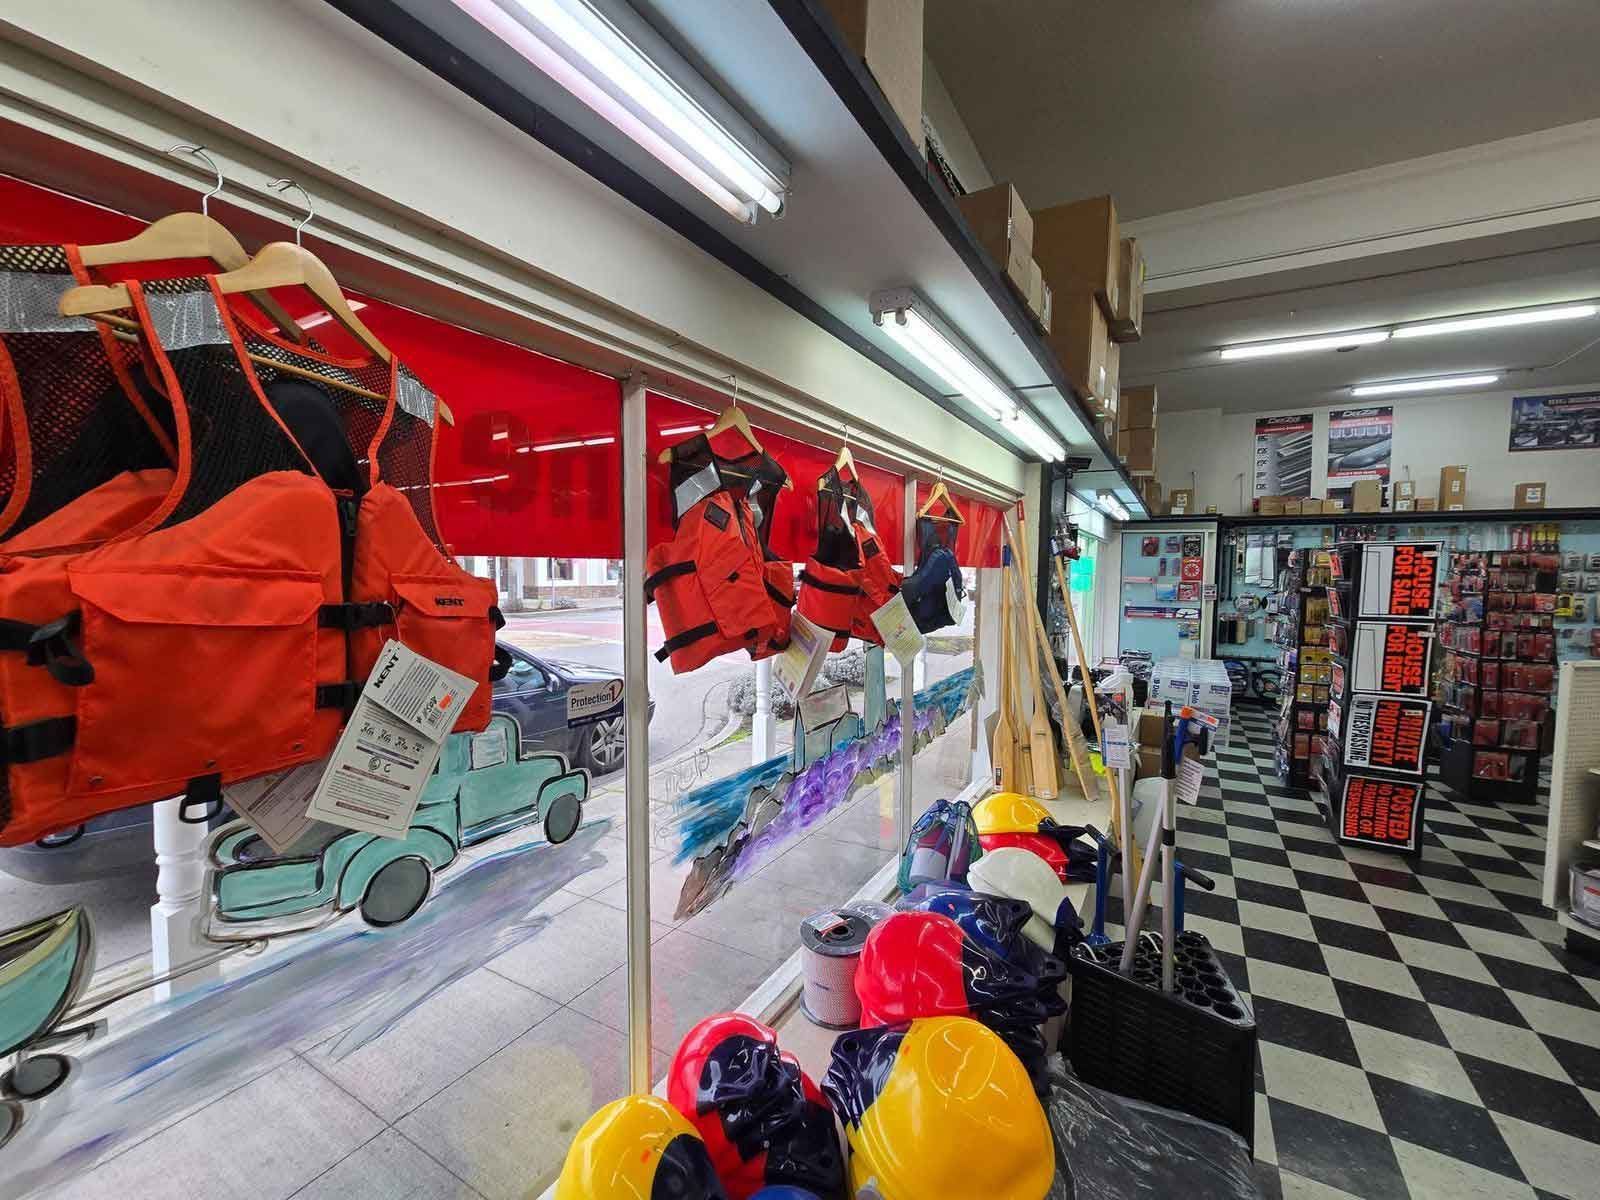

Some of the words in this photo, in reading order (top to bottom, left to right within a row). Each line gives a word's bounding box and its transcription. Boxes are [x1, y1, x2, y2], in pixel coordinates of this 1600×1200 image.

[1393, 546, 1415, 575] FOR
[1391, 579, 1411, 615] SALE
[1411, 552, 1433, 609] HOUSE
[1386, 625, 1407, 653] FOR
[374, 653, 399, 688] KENT
[1383, 655, 1404, 692] RENT
[1403, 632, 1425, 686] HOUSE
[571, 692, 611, 709] Protection
[1354, 700, 1374, 710] NO
[1350, 711, 1371, 762] TRESPASSING
[1371, 701, 1401, 765] PROPERTY
[1360, 783, 1377, 817] FISHING
[1378, 783, 1393, 795] NO
[1345, 778, 1364, 838] TRESPASSING
[1374, 796, 1391, 839] HUNTING
[1389, 787, 1415, 839] POSTED
[1359, 819, 1374, 834] OR
